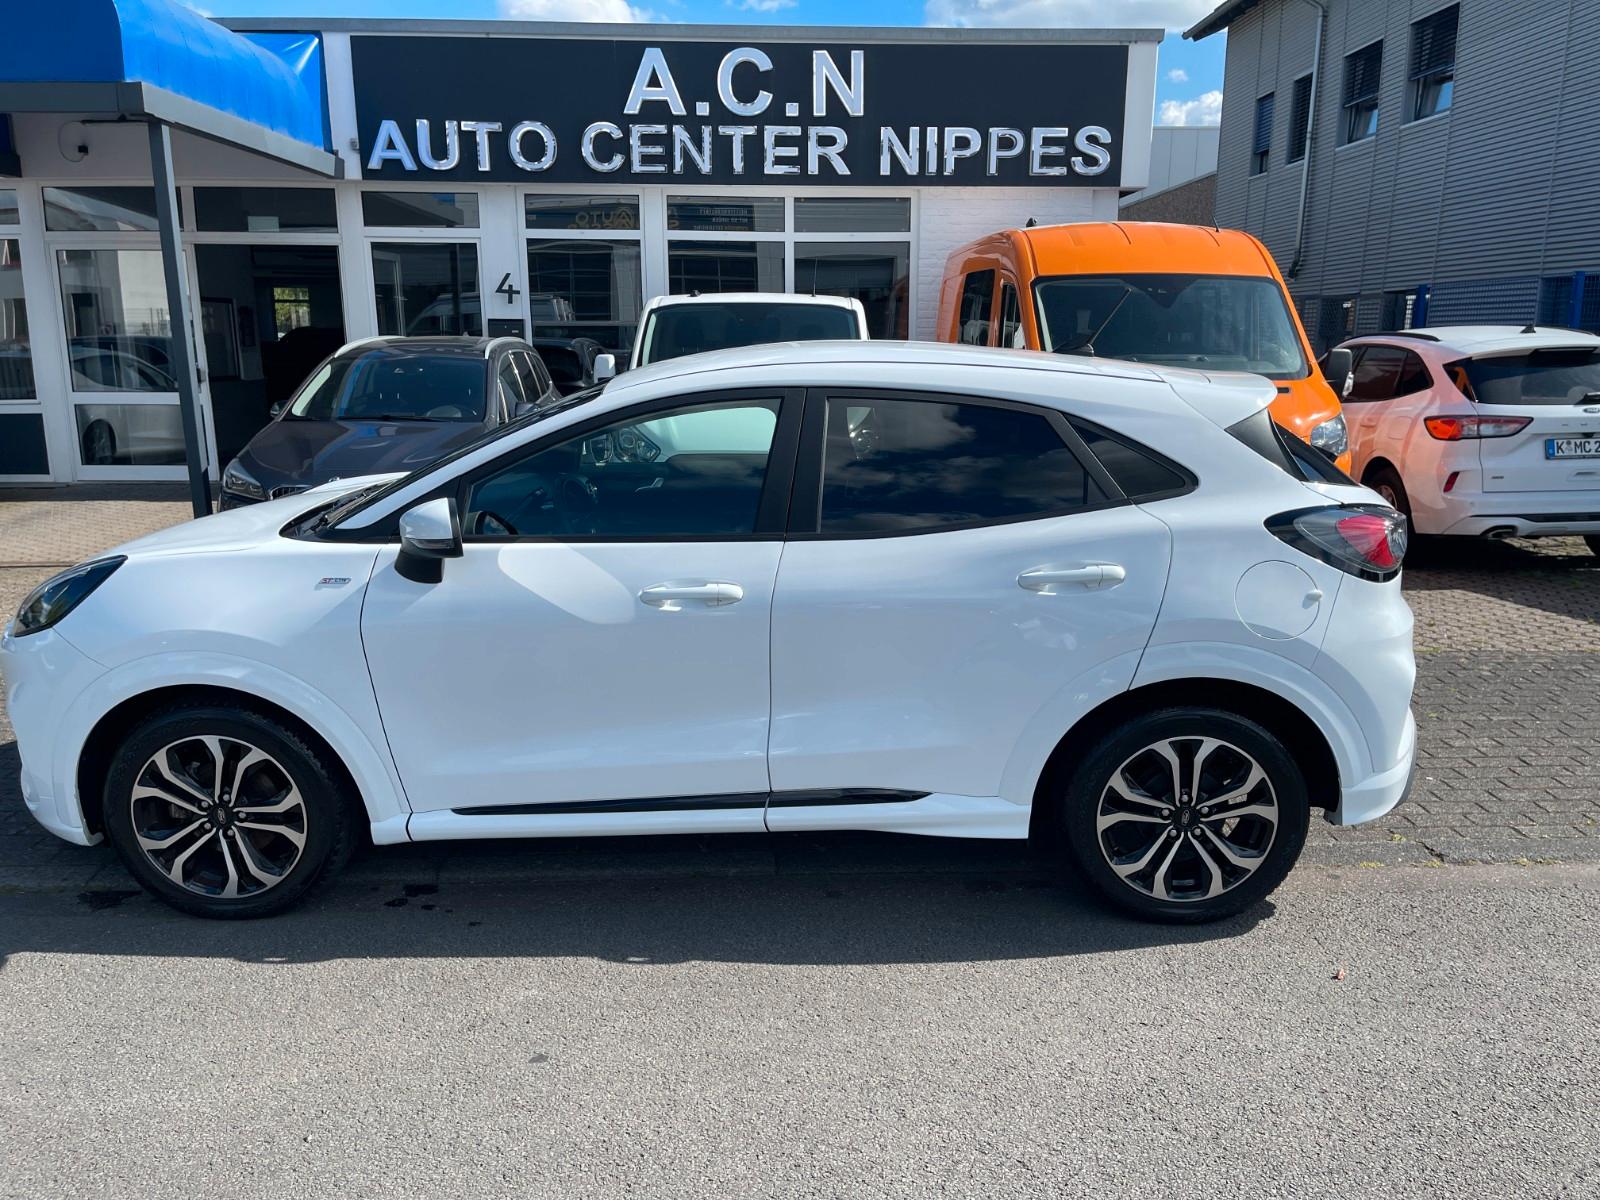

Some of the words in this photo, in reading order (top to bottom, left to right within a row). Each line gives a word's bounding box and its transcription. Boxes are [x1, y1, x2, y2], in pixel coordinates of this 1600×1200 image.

[623, 46, 865, 117] A.C.N
[367, 118, 558, 172] AUTO
[580, 120, 852, 176] CENTER
[879, 125, 1113, 177] NIPPES
[495, 273, 521, 304] 4
[1574, 441, 1591, 454] MC
